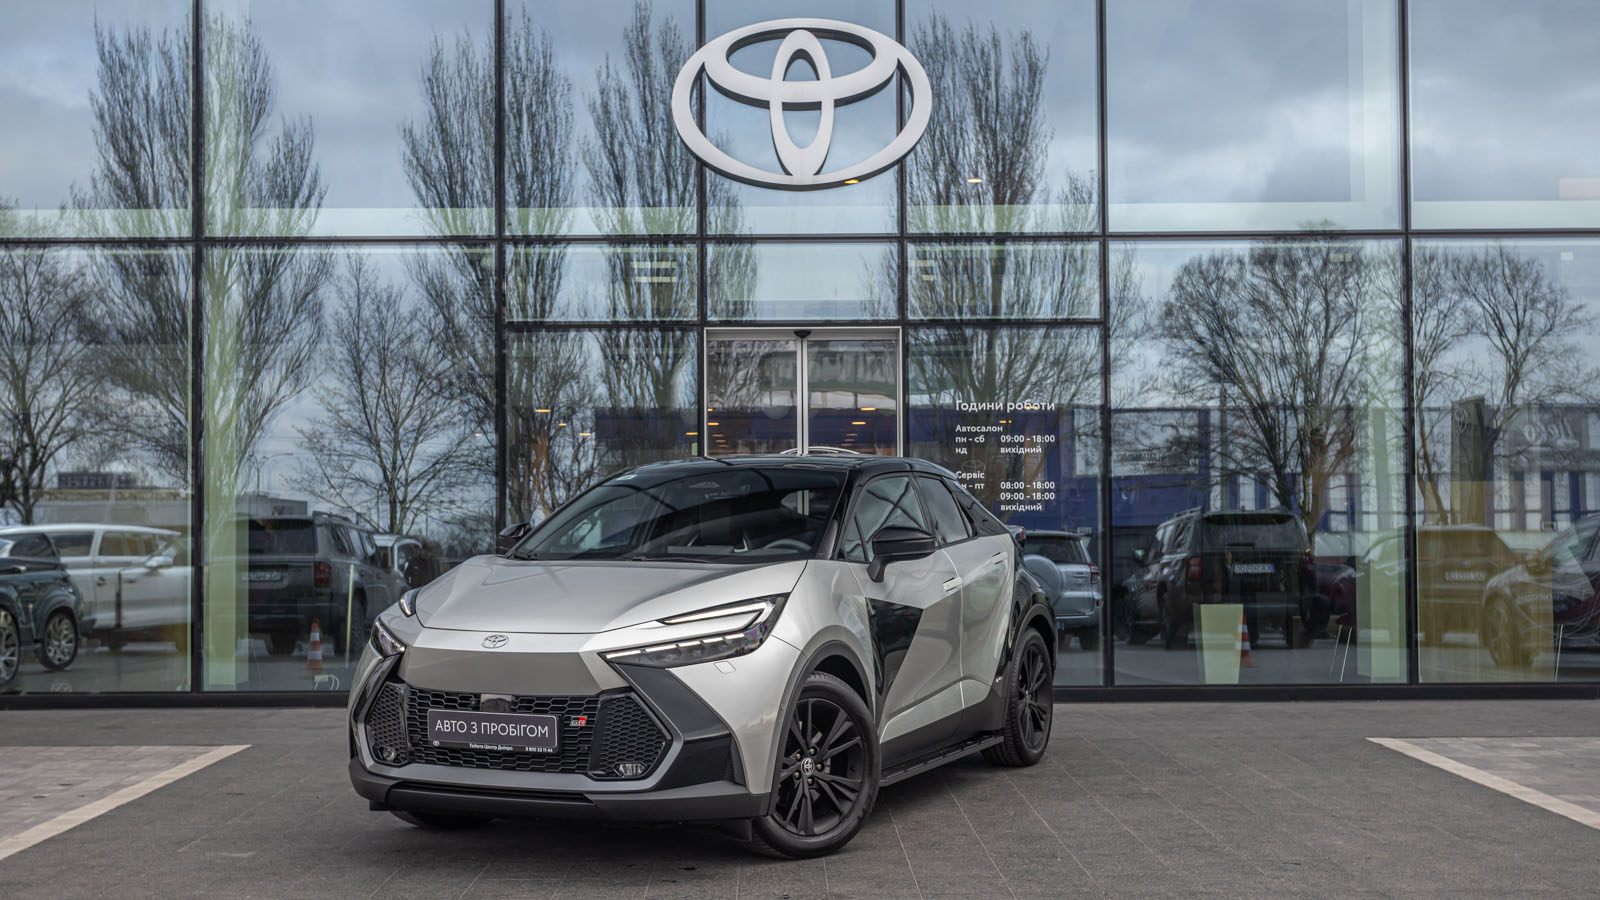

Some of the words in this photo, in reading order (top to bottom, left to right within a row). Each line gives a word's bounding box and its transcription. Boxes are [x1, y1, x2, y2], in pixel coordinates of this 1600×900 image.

[955, 400, 1003, 412] Години
[1007, 399, 1055, 413] роботи
[955, 424, 1003, 433] Автосалон
[974, 434, 985, 443] сб
[1000, 435, 1025, 443] 09:00
[1032, 435, 1055, 443] 18:00
[955, 447, 968, 455] нд
[1000, 445, 1042, 455] вихідний
[956, 470, 985, 480] Сервіс
[1000, 481, 1025, 490] 08:00
[1032, 481, 1055, 490] 18:00
[1000, 492, 1025, 500] 09:00
[1032, 492, 1055, 500] 18:00
[1000, 503, 1042, 512] вихідний
[435, 720, 467, 733] АВТО
[481, 722, 549, 738] ПРОБІГОМ
